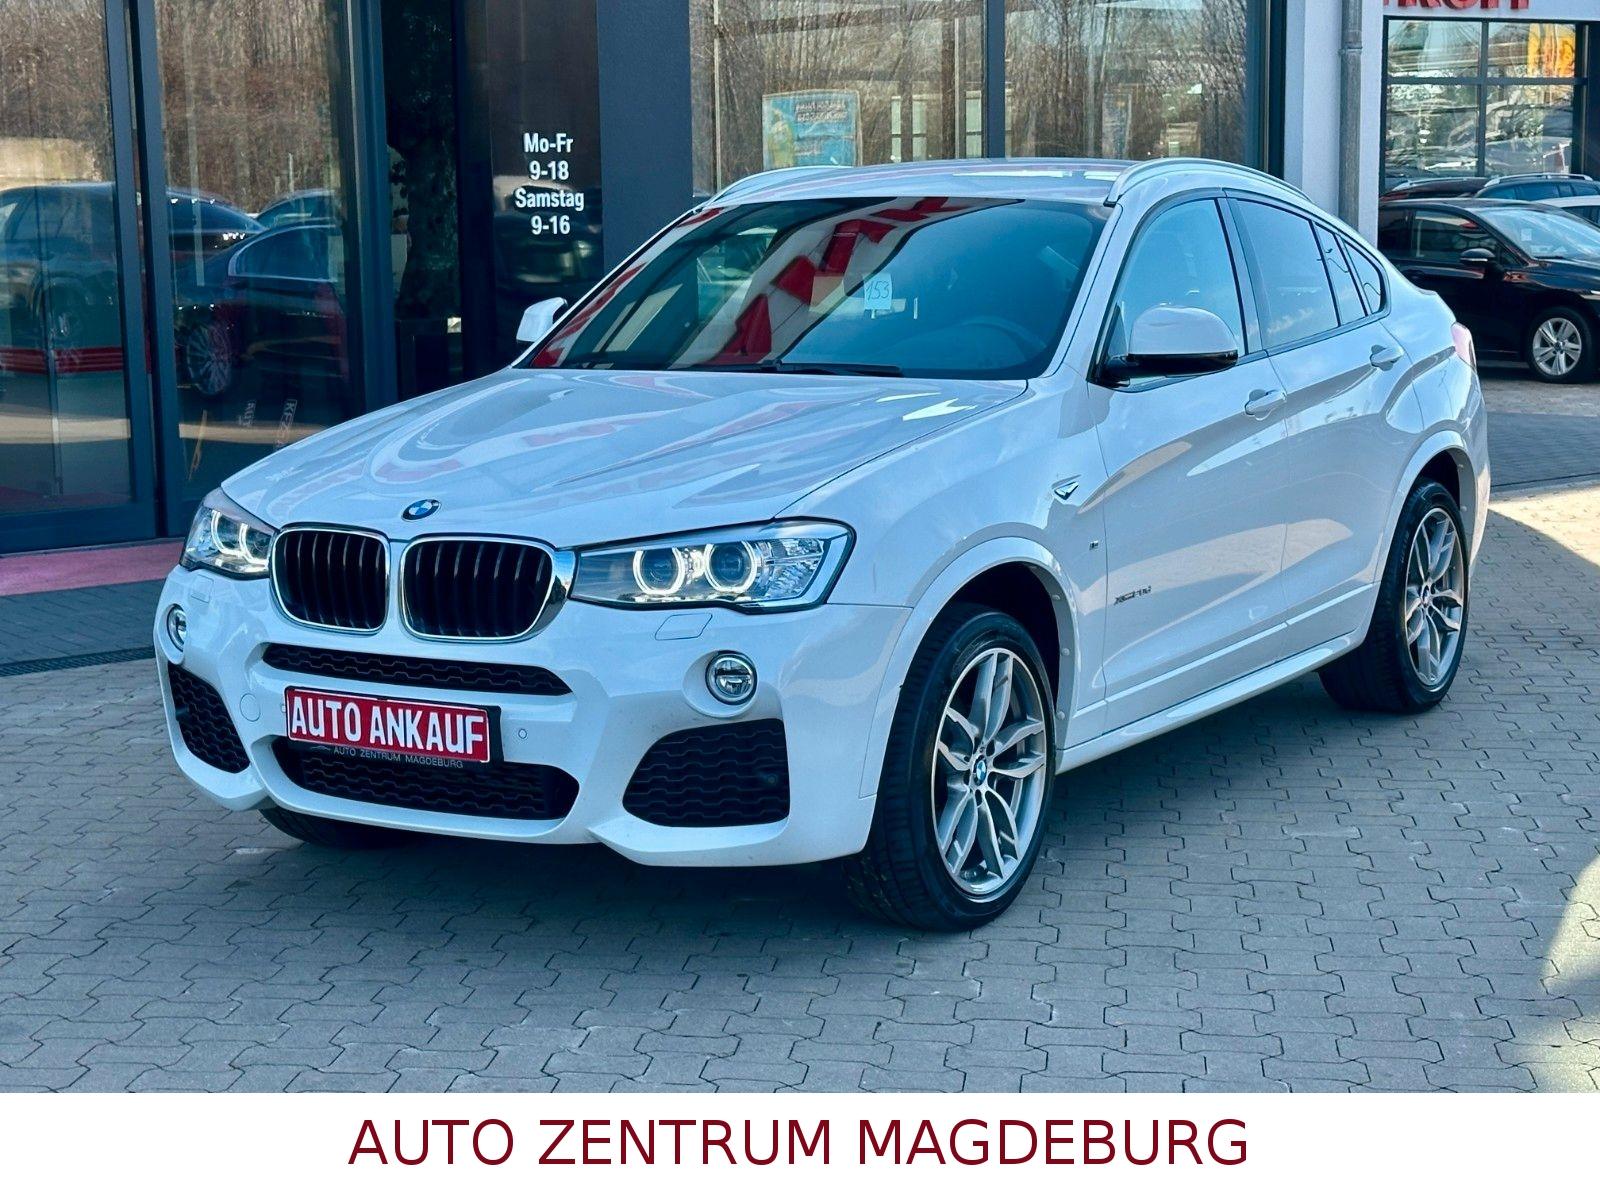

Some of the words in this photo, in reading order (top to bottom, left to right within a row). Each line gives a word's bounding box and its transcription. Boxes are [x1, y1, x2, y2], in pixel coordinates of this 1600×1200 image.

[523, 132, 574, 153] Mo-Fr
[529, 160, 570, 181] 9-18
[514, 187, 585, 212] Samstag
[531, 215, 571, 235] 9-16
[866, 280, 890, 302] 153
[291, 696, 362, 742] AUTO
[369, 706, 484, 755] ANKAUF
[333, 747, 357, 757] AUTO
[360, 749, 401, 762] ZENTRUM
[405, 755, 464, 769] MAGDEBURG
